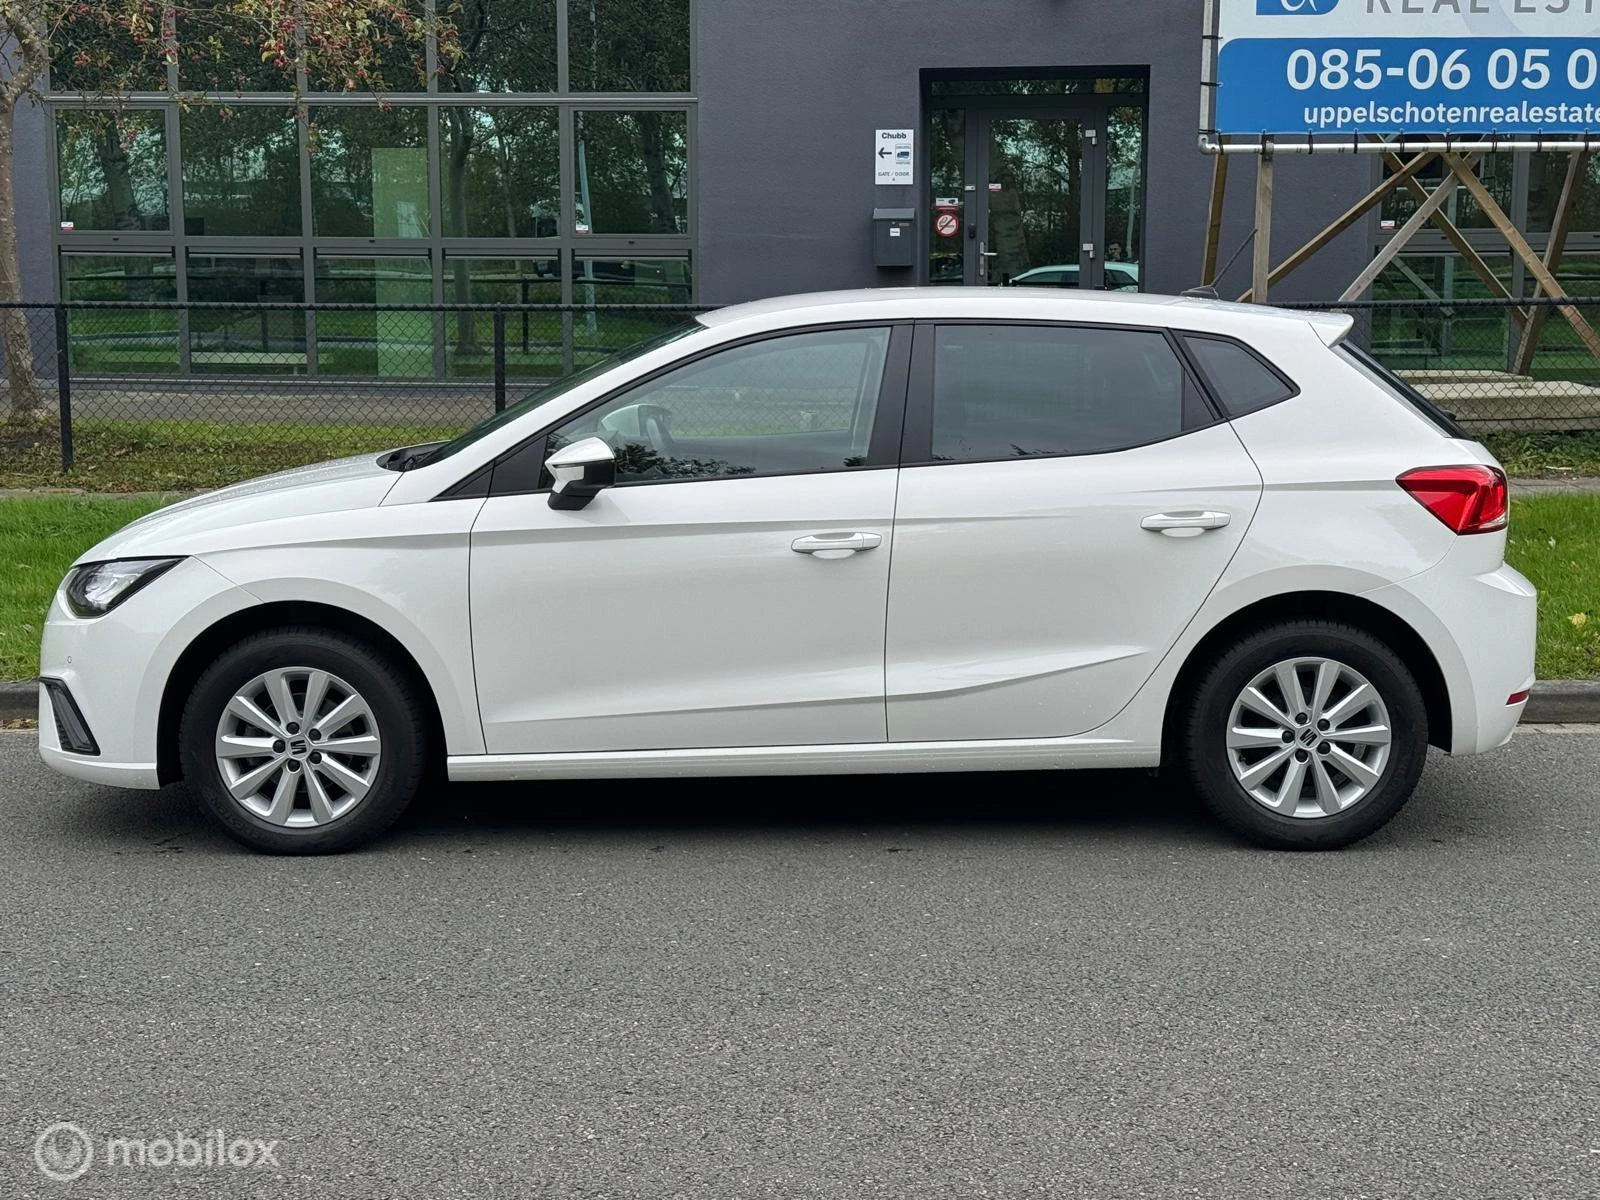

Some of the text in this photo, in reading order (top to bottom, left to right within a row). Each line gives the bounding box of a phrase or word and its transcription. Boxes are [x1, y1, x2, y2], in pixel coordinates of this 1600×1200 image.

[1286, 48, 1598, 91] 085-06 05 0
